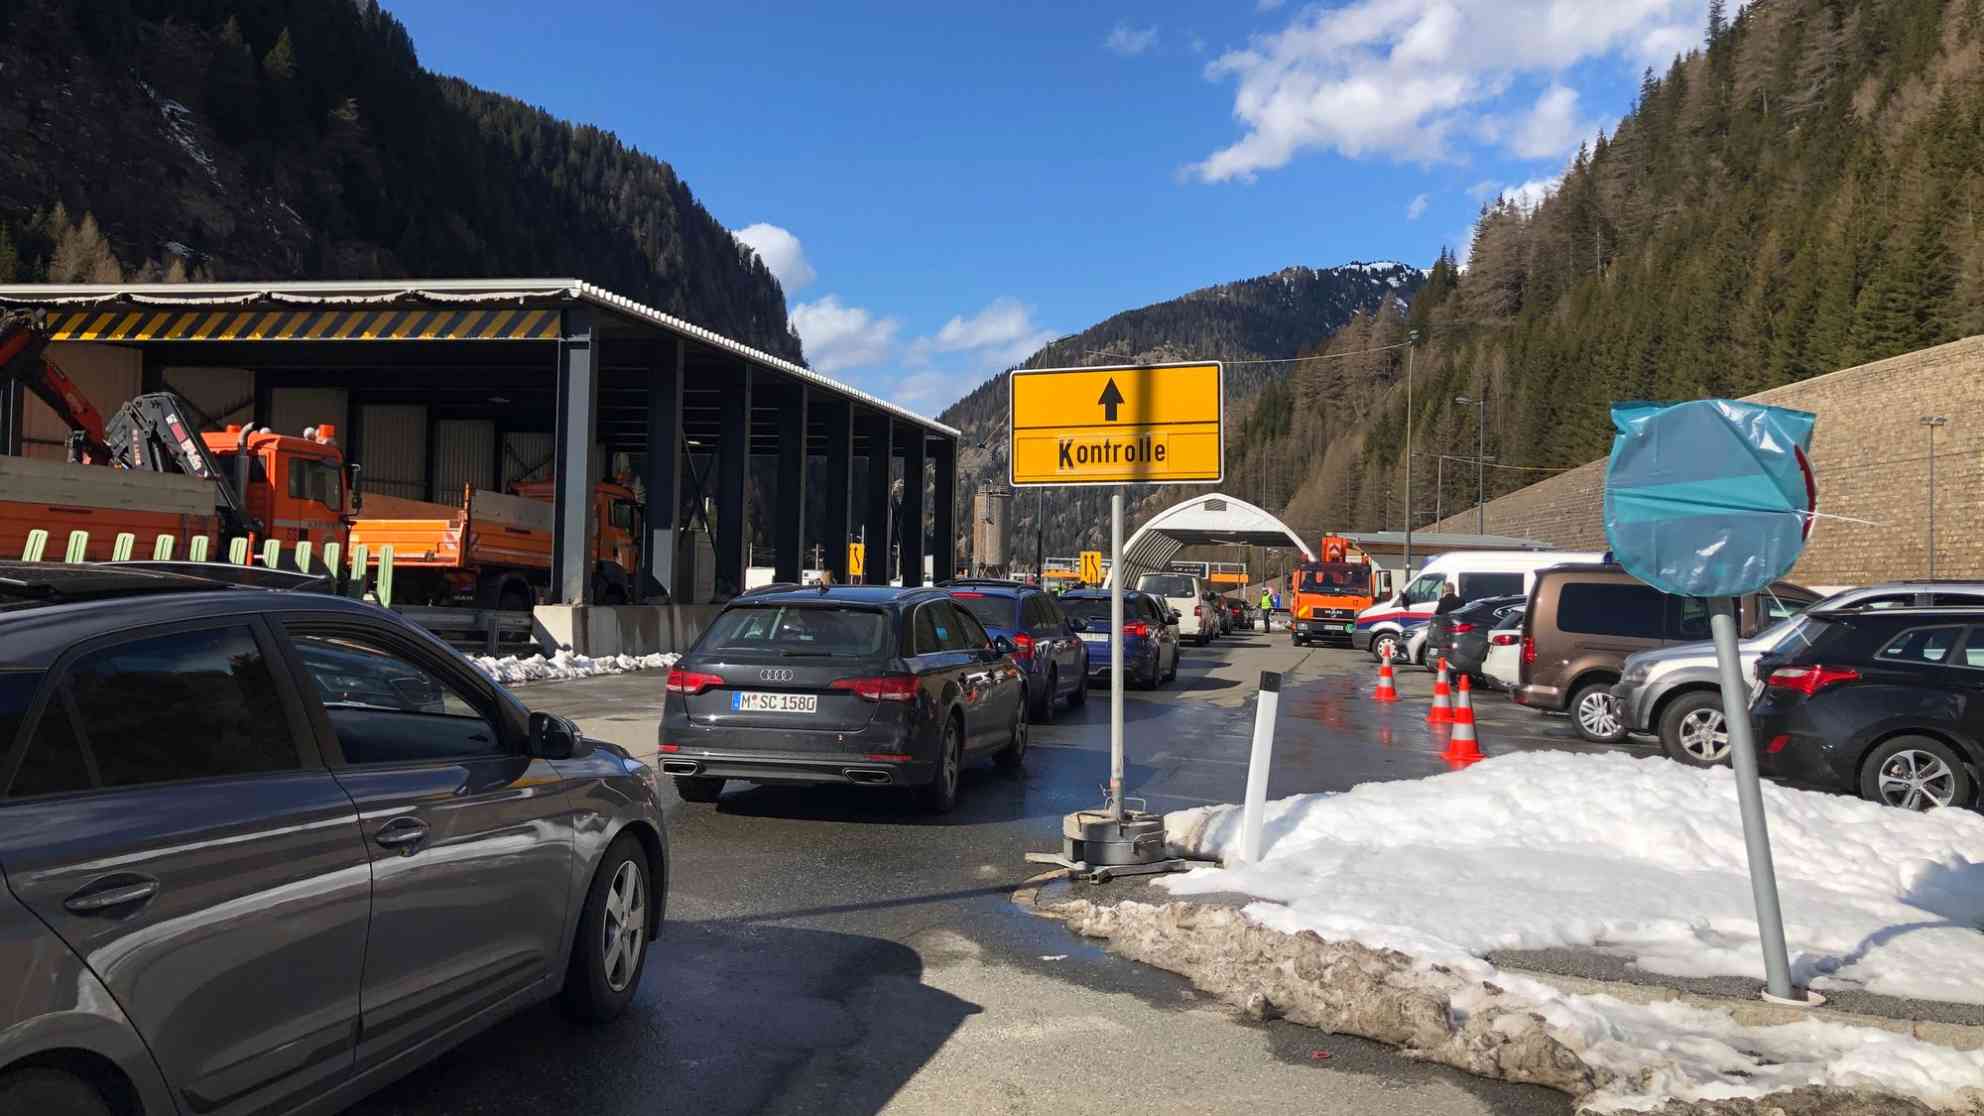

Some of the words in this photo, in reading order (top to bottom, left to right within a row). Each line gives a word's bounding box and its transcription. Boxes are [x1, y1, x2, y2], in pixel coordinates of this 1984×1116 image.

[1058, 436, 1166, 469] Kontrolle
[741, 695, 751, 708] M
[760, 695, 777, 709] SC
[780, 696, 815, 711] 1580
